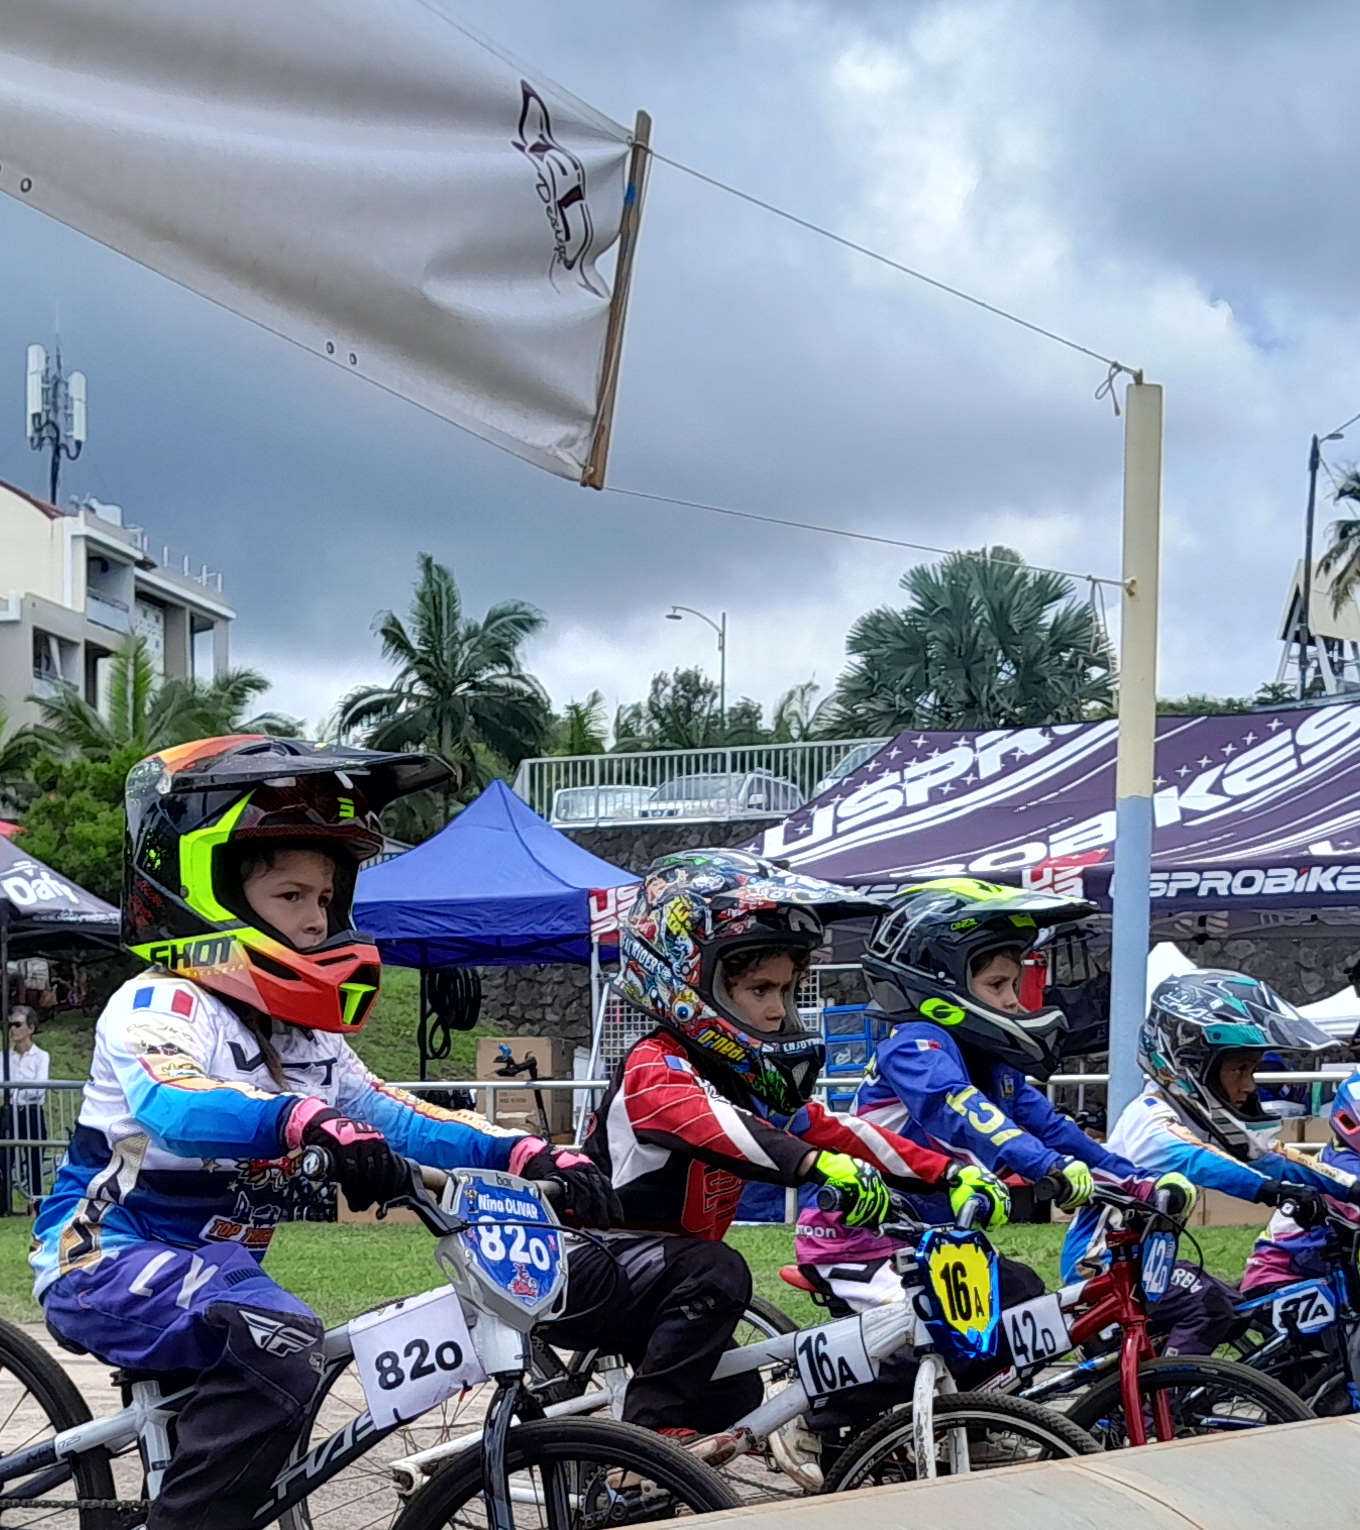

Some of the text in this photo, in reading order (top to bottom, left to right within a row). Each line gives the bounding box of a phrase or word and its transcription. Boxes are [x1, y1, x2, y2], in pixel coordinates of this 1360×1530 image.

[149, 934, 238, 971] SHOT
[477, 1215, 551, 1271] 820
[939, 1260, 985, 1322] 16A
[798, 1331, 859, 1394] 16A
[1011, 1309, 1057, 1363] 42D
[375, 1338, 464, 1391] 820
